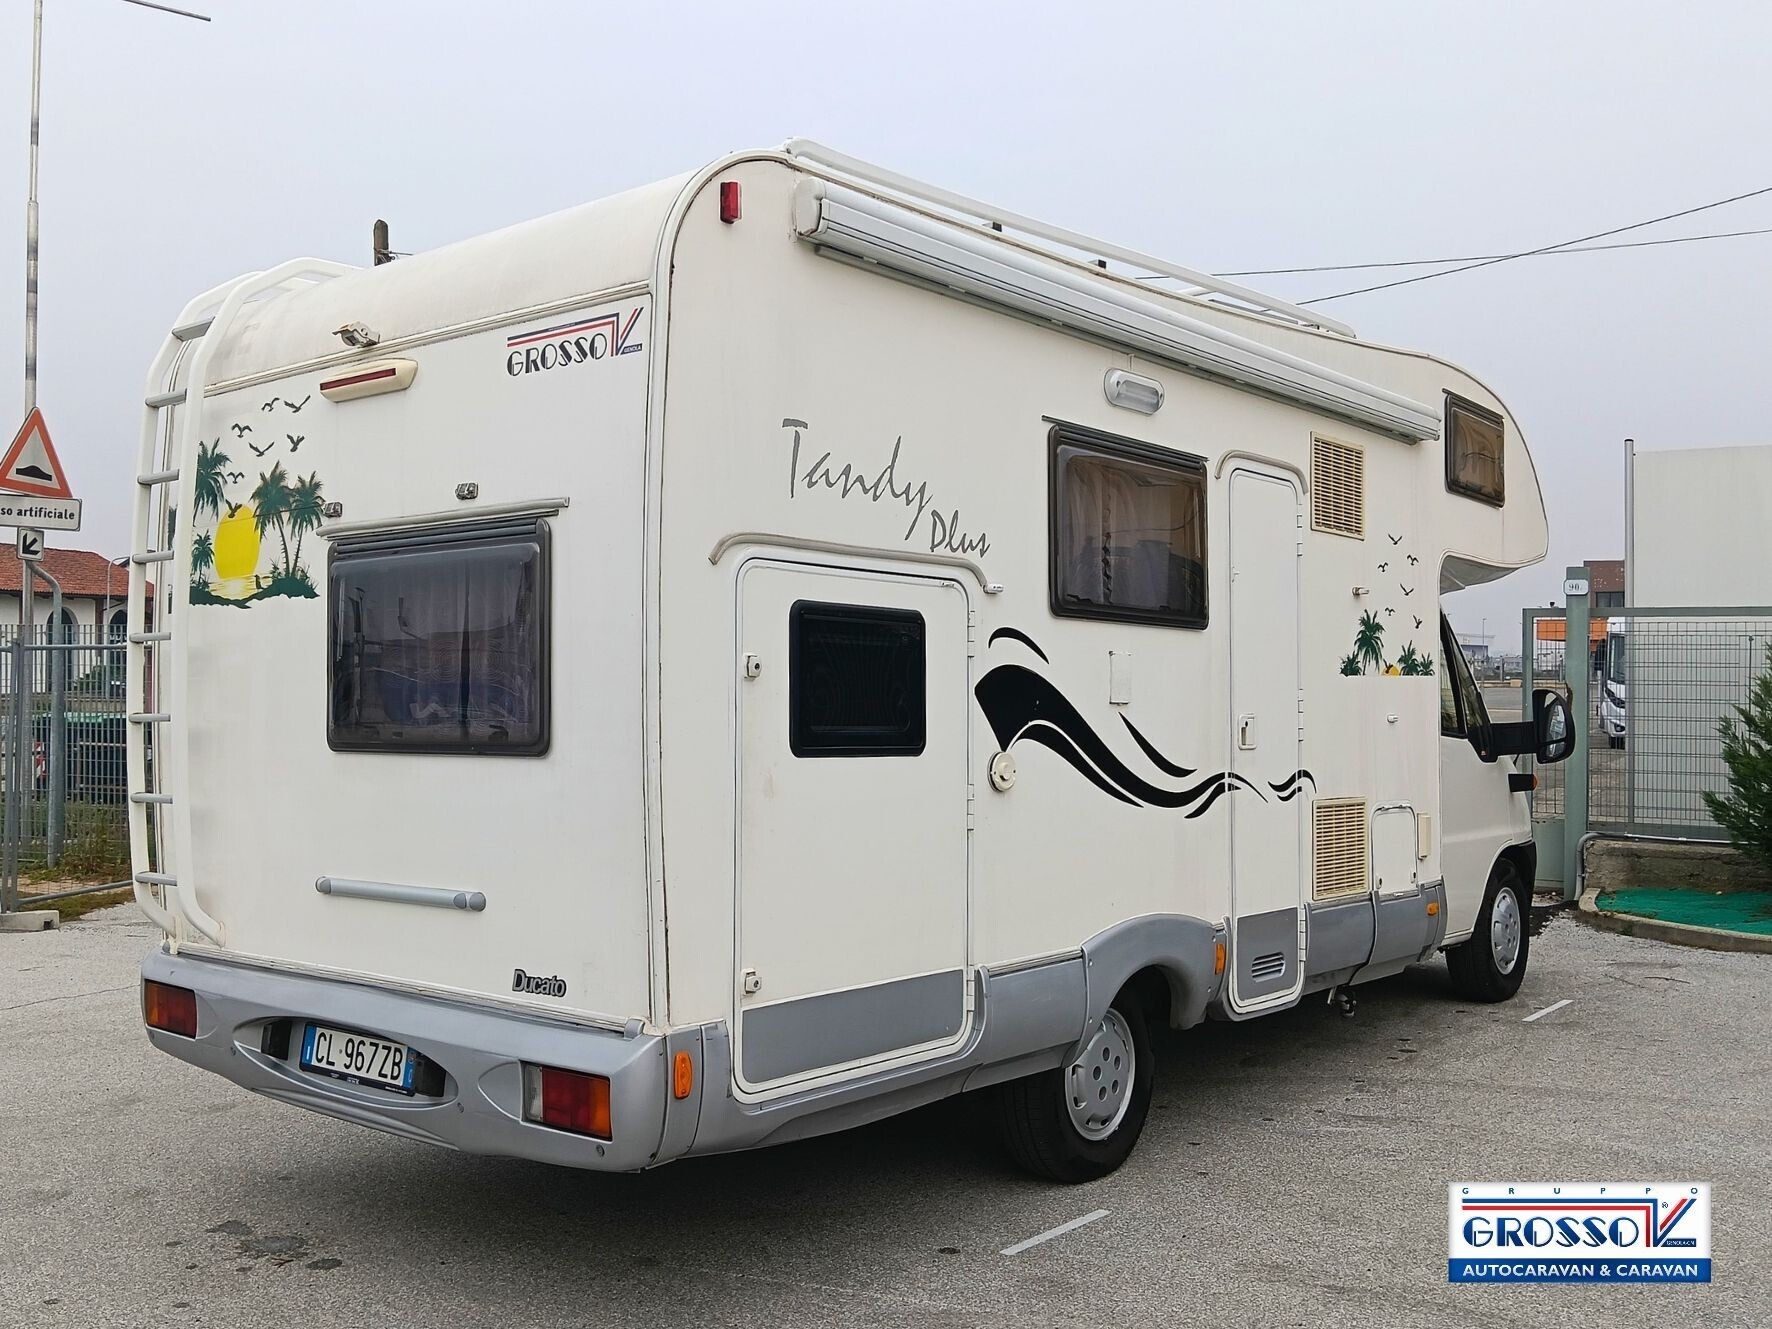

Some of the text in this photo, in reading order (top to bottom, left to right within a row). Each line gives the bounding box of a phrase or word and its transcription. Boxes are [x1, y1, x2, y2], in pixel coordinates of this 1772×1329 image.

[507, 333, 608, 377] GROSSO
[782, 418, 933, 541] Tandy
[0, 506, 75, 520] so artificiale
[512, 968, 567, 998] Ducato
